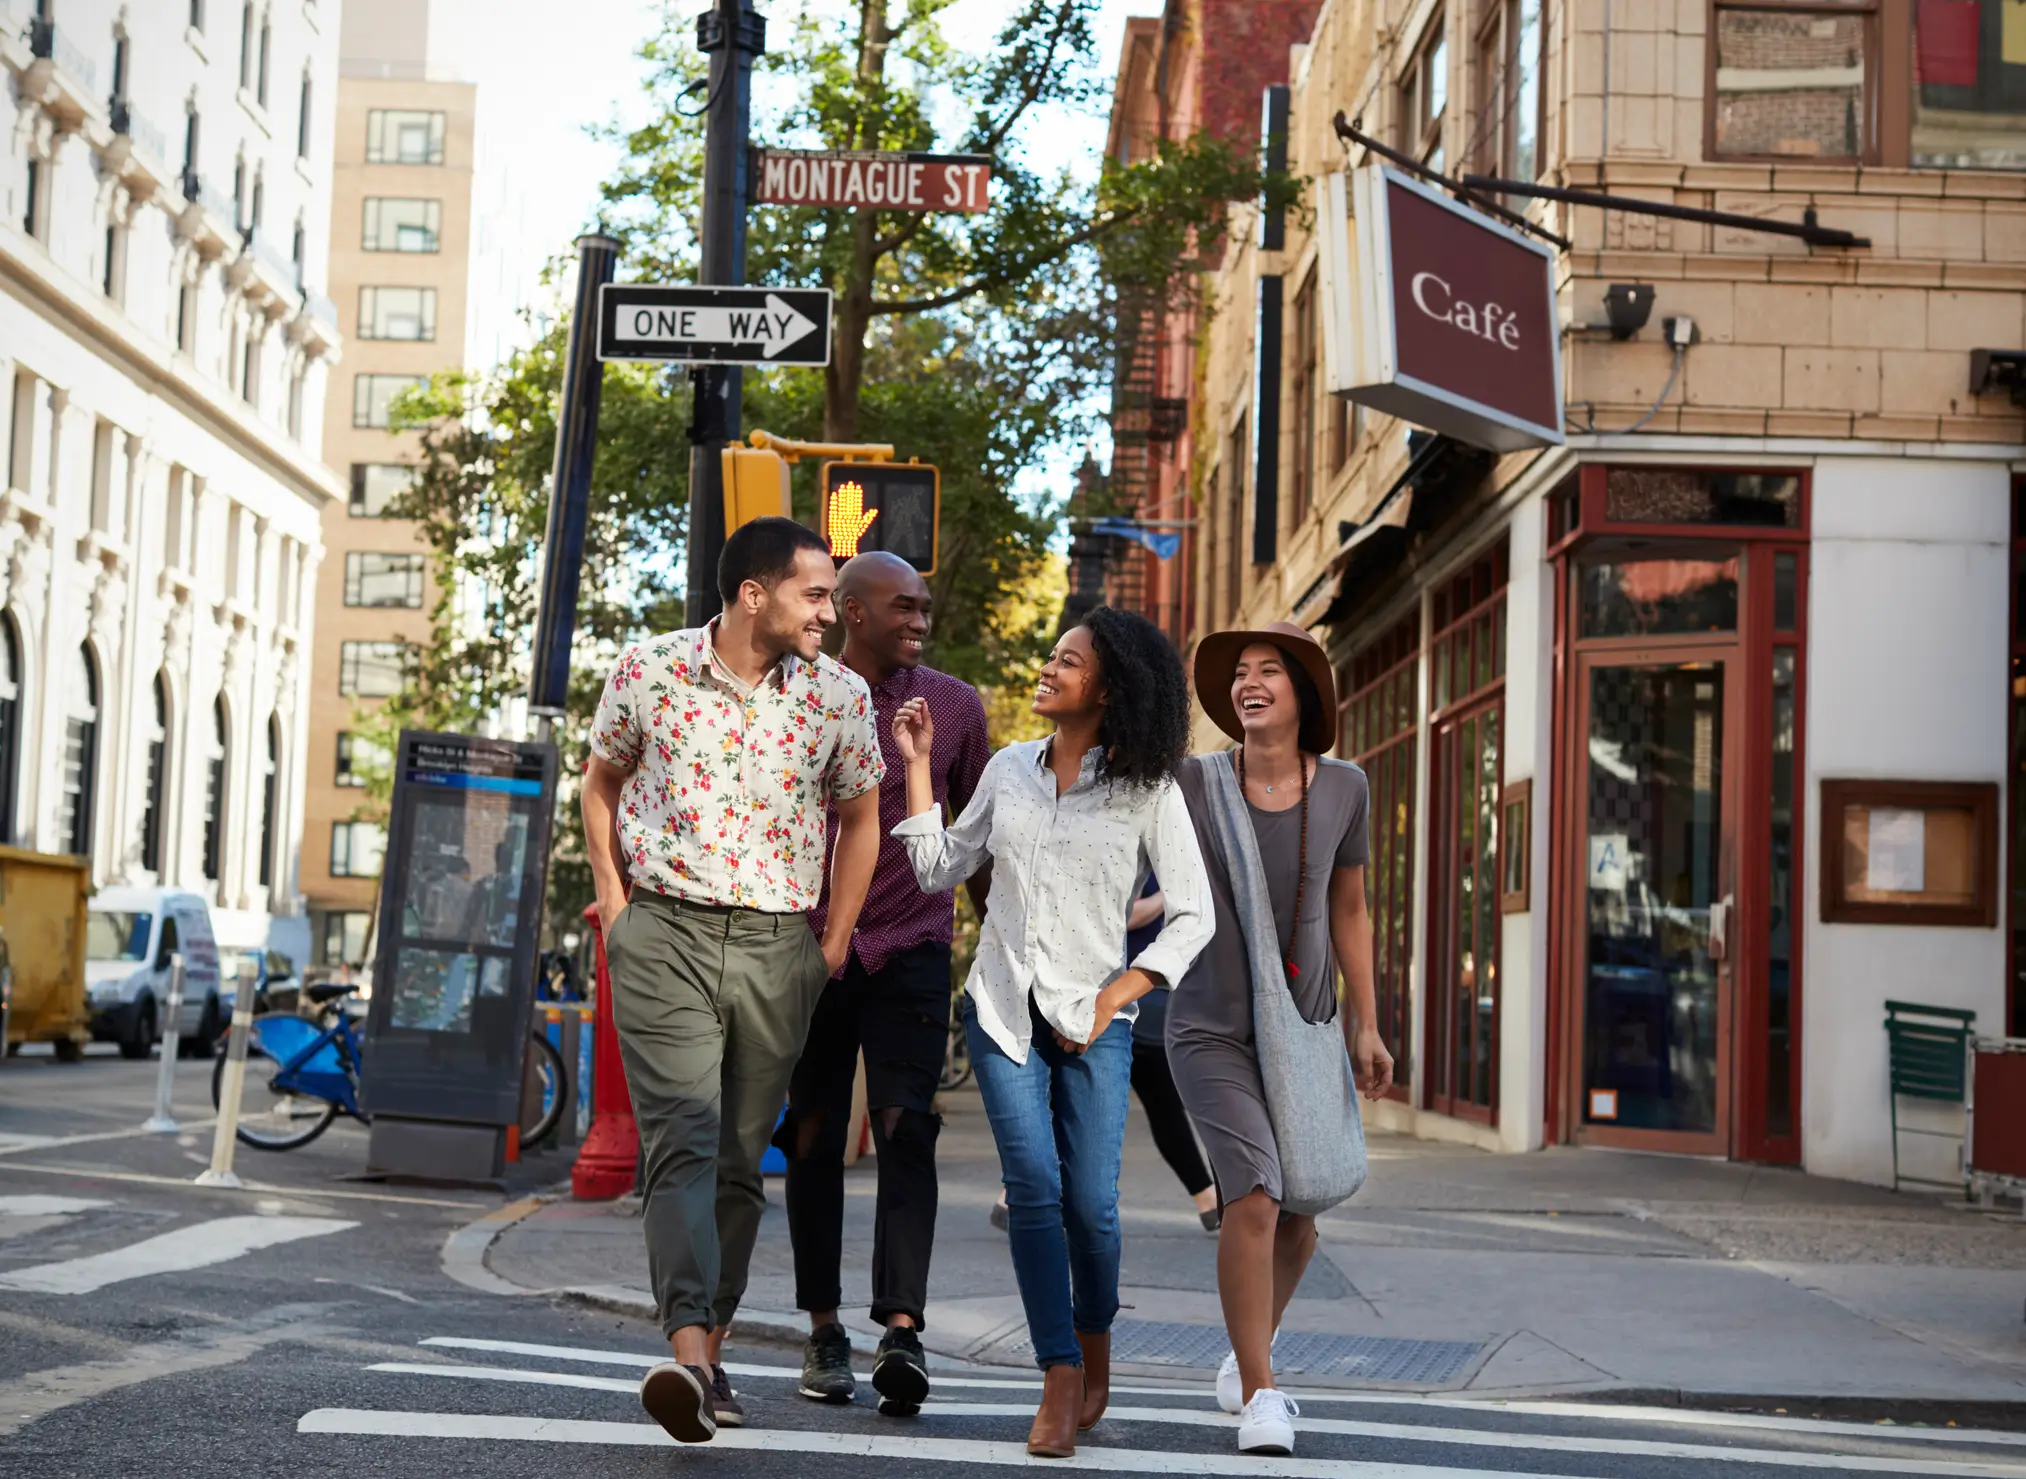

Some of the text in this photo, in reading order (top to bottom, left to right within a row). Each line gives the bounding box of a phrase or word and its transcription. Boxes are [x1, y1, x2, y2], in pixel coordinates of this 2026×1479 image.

[764, 158, 981, 207] MONTAGUE ST
[634, 310, 793, 340] ONE WAY
[1411, 271, 1520, 350] Café
[1597, 842, 1620, 873] A
